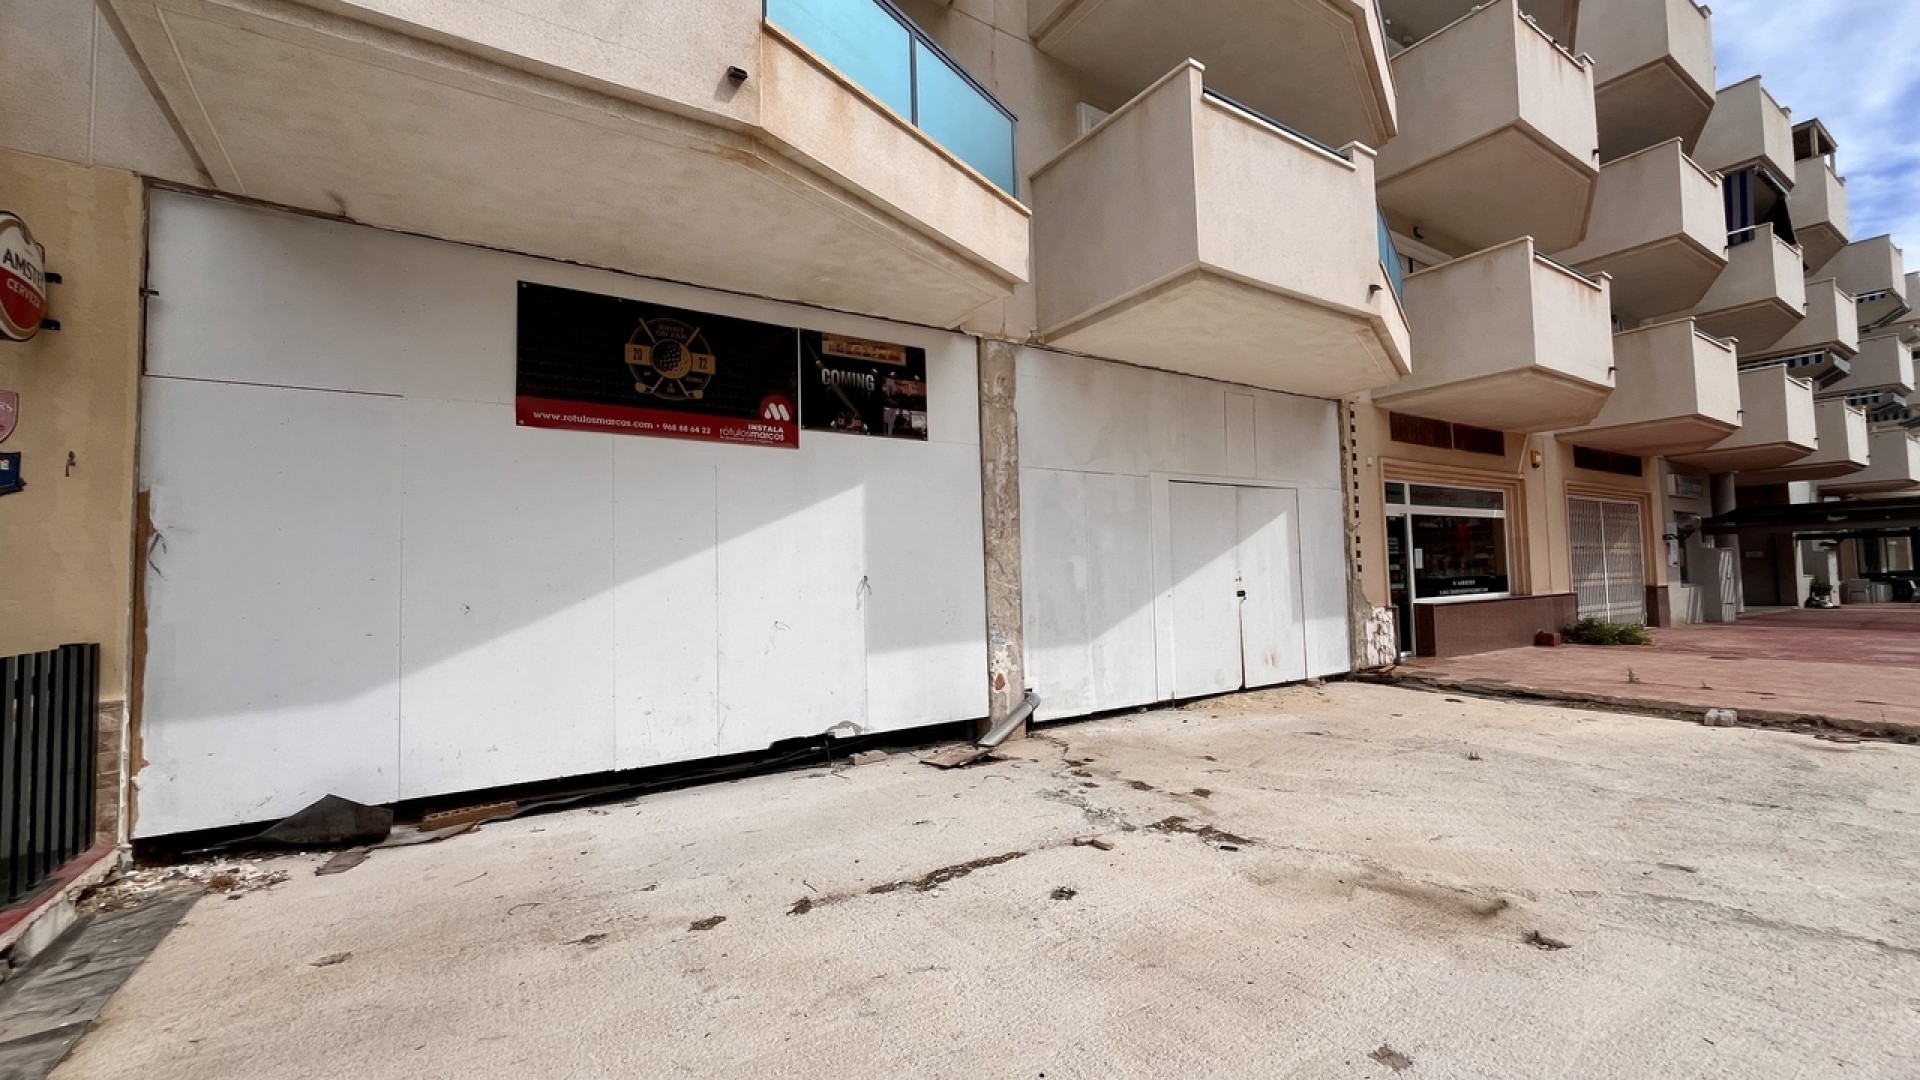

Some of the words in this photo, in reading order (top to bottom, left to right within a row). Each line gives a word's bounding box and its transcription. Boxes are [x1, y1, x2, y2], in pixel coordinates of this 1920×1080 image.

[632, 347, 643, 361] 20
[698, 356, 707, 370] 22
[821, 367, 875, 391] COMING
[533, 411, 654, 430] www.rotulosmarcos.com
[663, 422, 677, 431] 968
[749, 424, 784, 433] INSTALA
